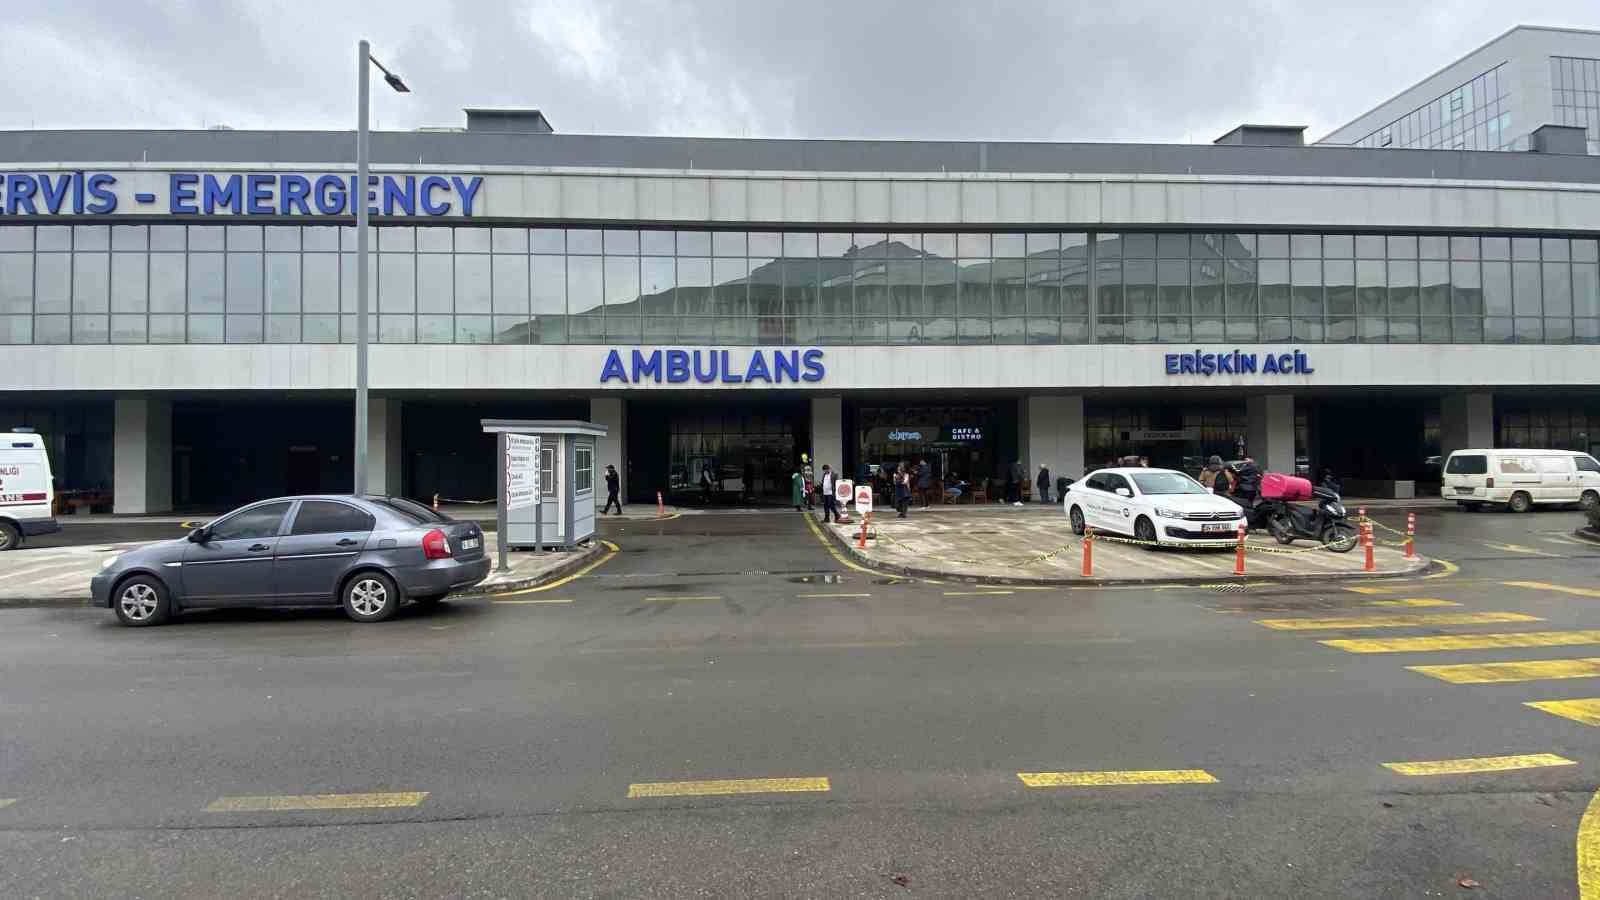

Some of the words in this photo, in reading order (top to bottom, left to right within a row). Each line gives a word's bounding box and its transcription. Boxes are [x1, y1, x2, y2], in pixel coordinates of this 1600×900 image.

[0, 169, 118, 215] RVİS
[170, 172, 484, 217] EMERGENCY
[600, 349, 825, 384] AMBULANS
[1165, 349, 1257, 376] ERİŞKİN
[1263, 349, 1314, 375] ACİL
